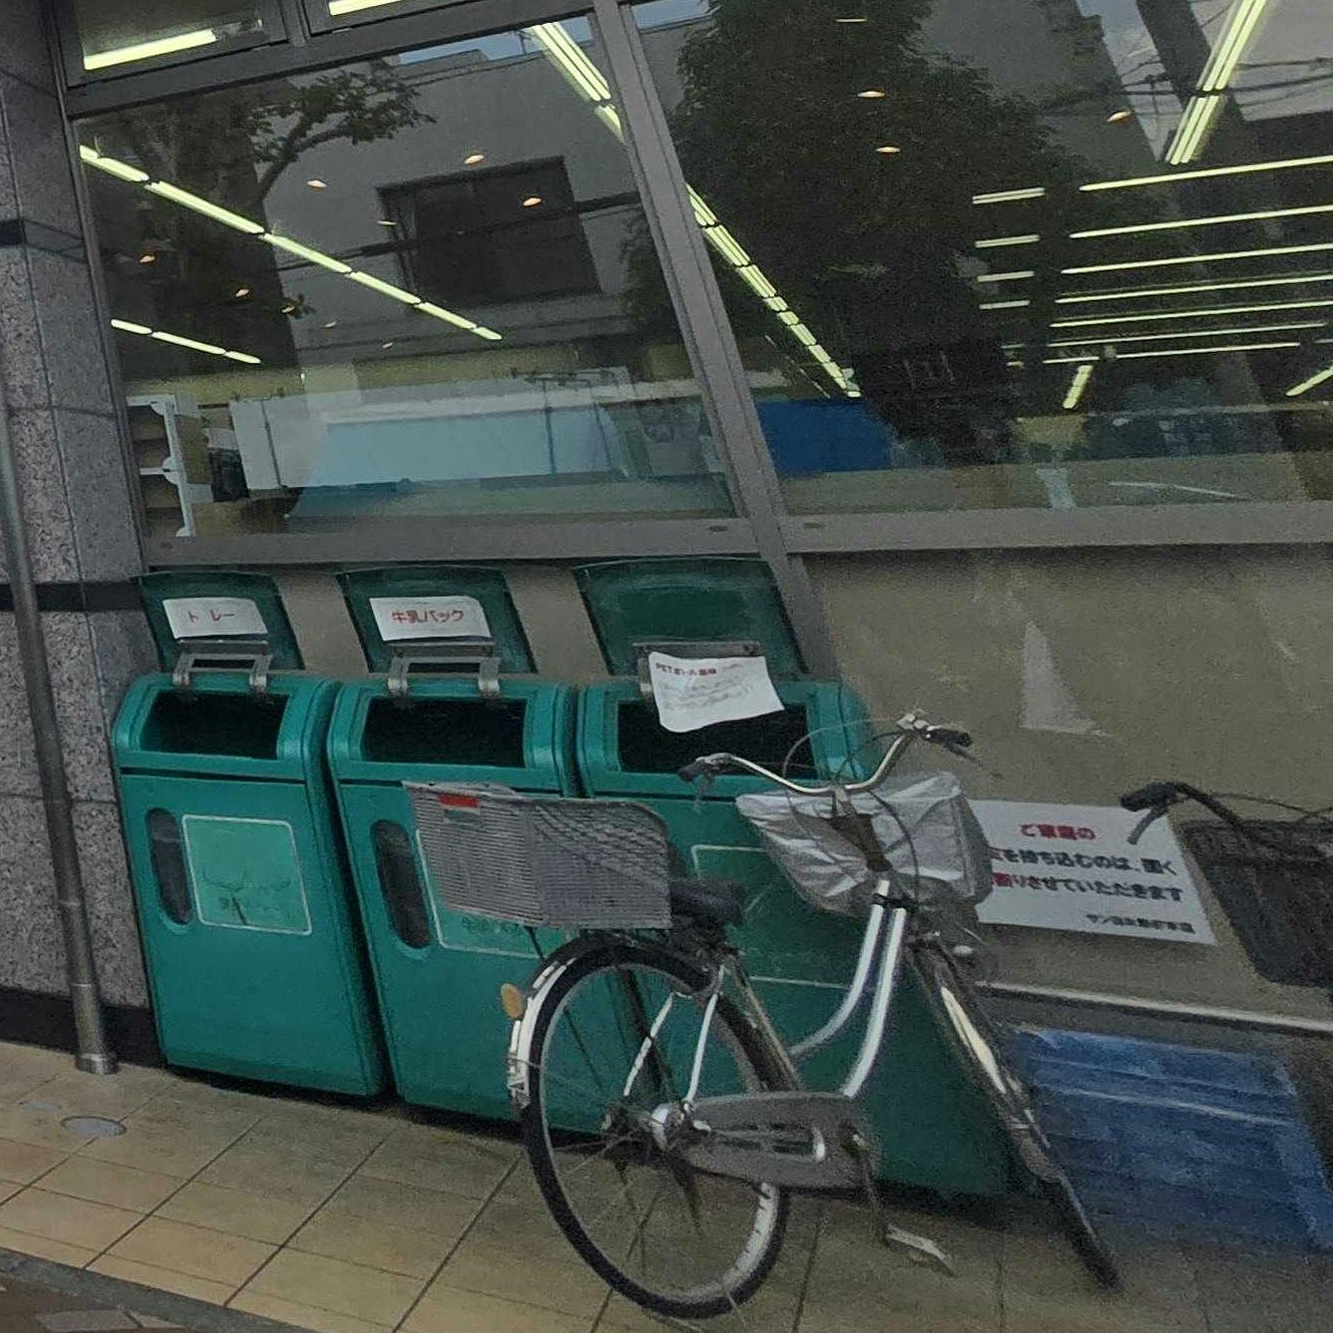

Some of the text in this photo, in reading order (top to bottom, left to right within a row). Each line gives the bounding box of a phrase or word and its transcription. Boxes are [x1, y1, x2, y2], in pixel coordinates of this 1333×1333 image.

[391, 609, 464, 624] 牛乳パック
